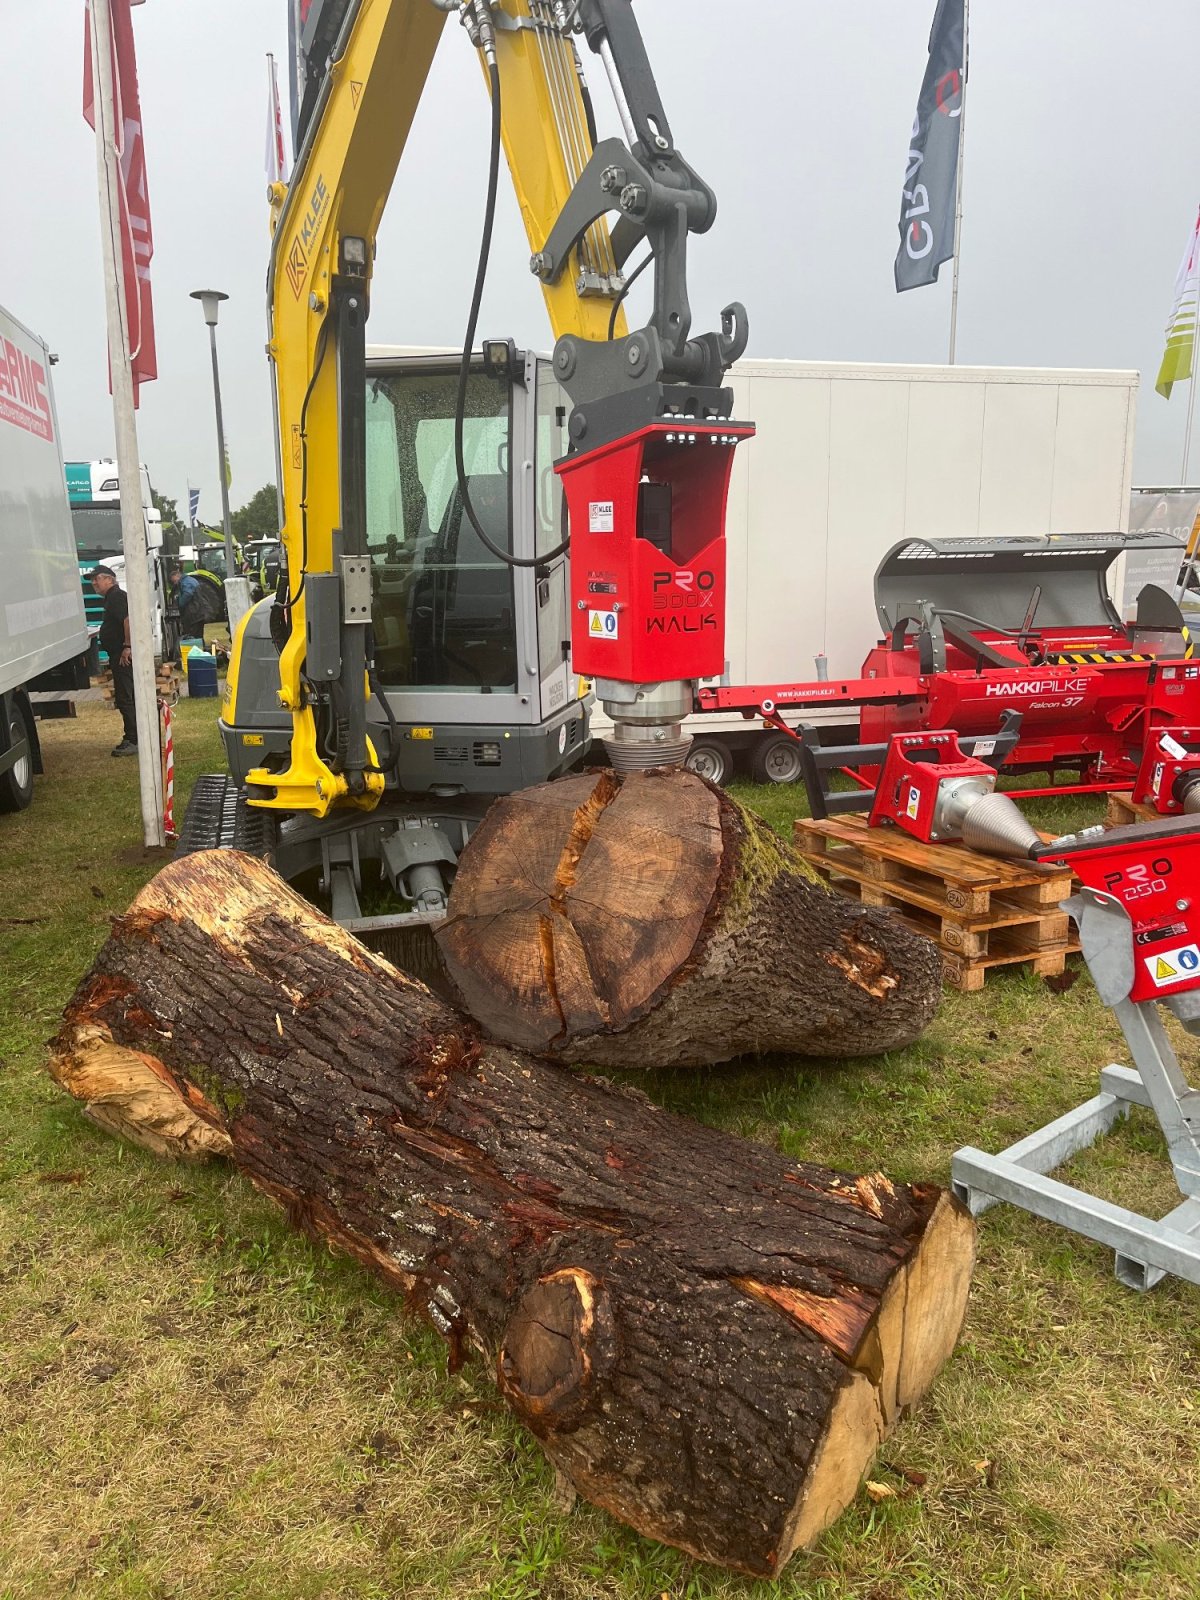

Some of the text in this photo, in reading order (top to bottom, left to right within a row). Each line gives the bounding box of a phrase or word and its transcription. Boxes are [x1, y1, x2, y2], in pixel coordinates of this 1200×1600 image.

[301, 173, 327, 245] KLEE
[653, 570, 715, 592] PRO
[647, 614, 717, 633] WALK
[986, 679, 1088, 696] HAKKIPILKE
[1062, 697, 1083, 707] 37
[1103, 857, 1173, 891] PRO
[1123, 879, 1167, 901] 250
